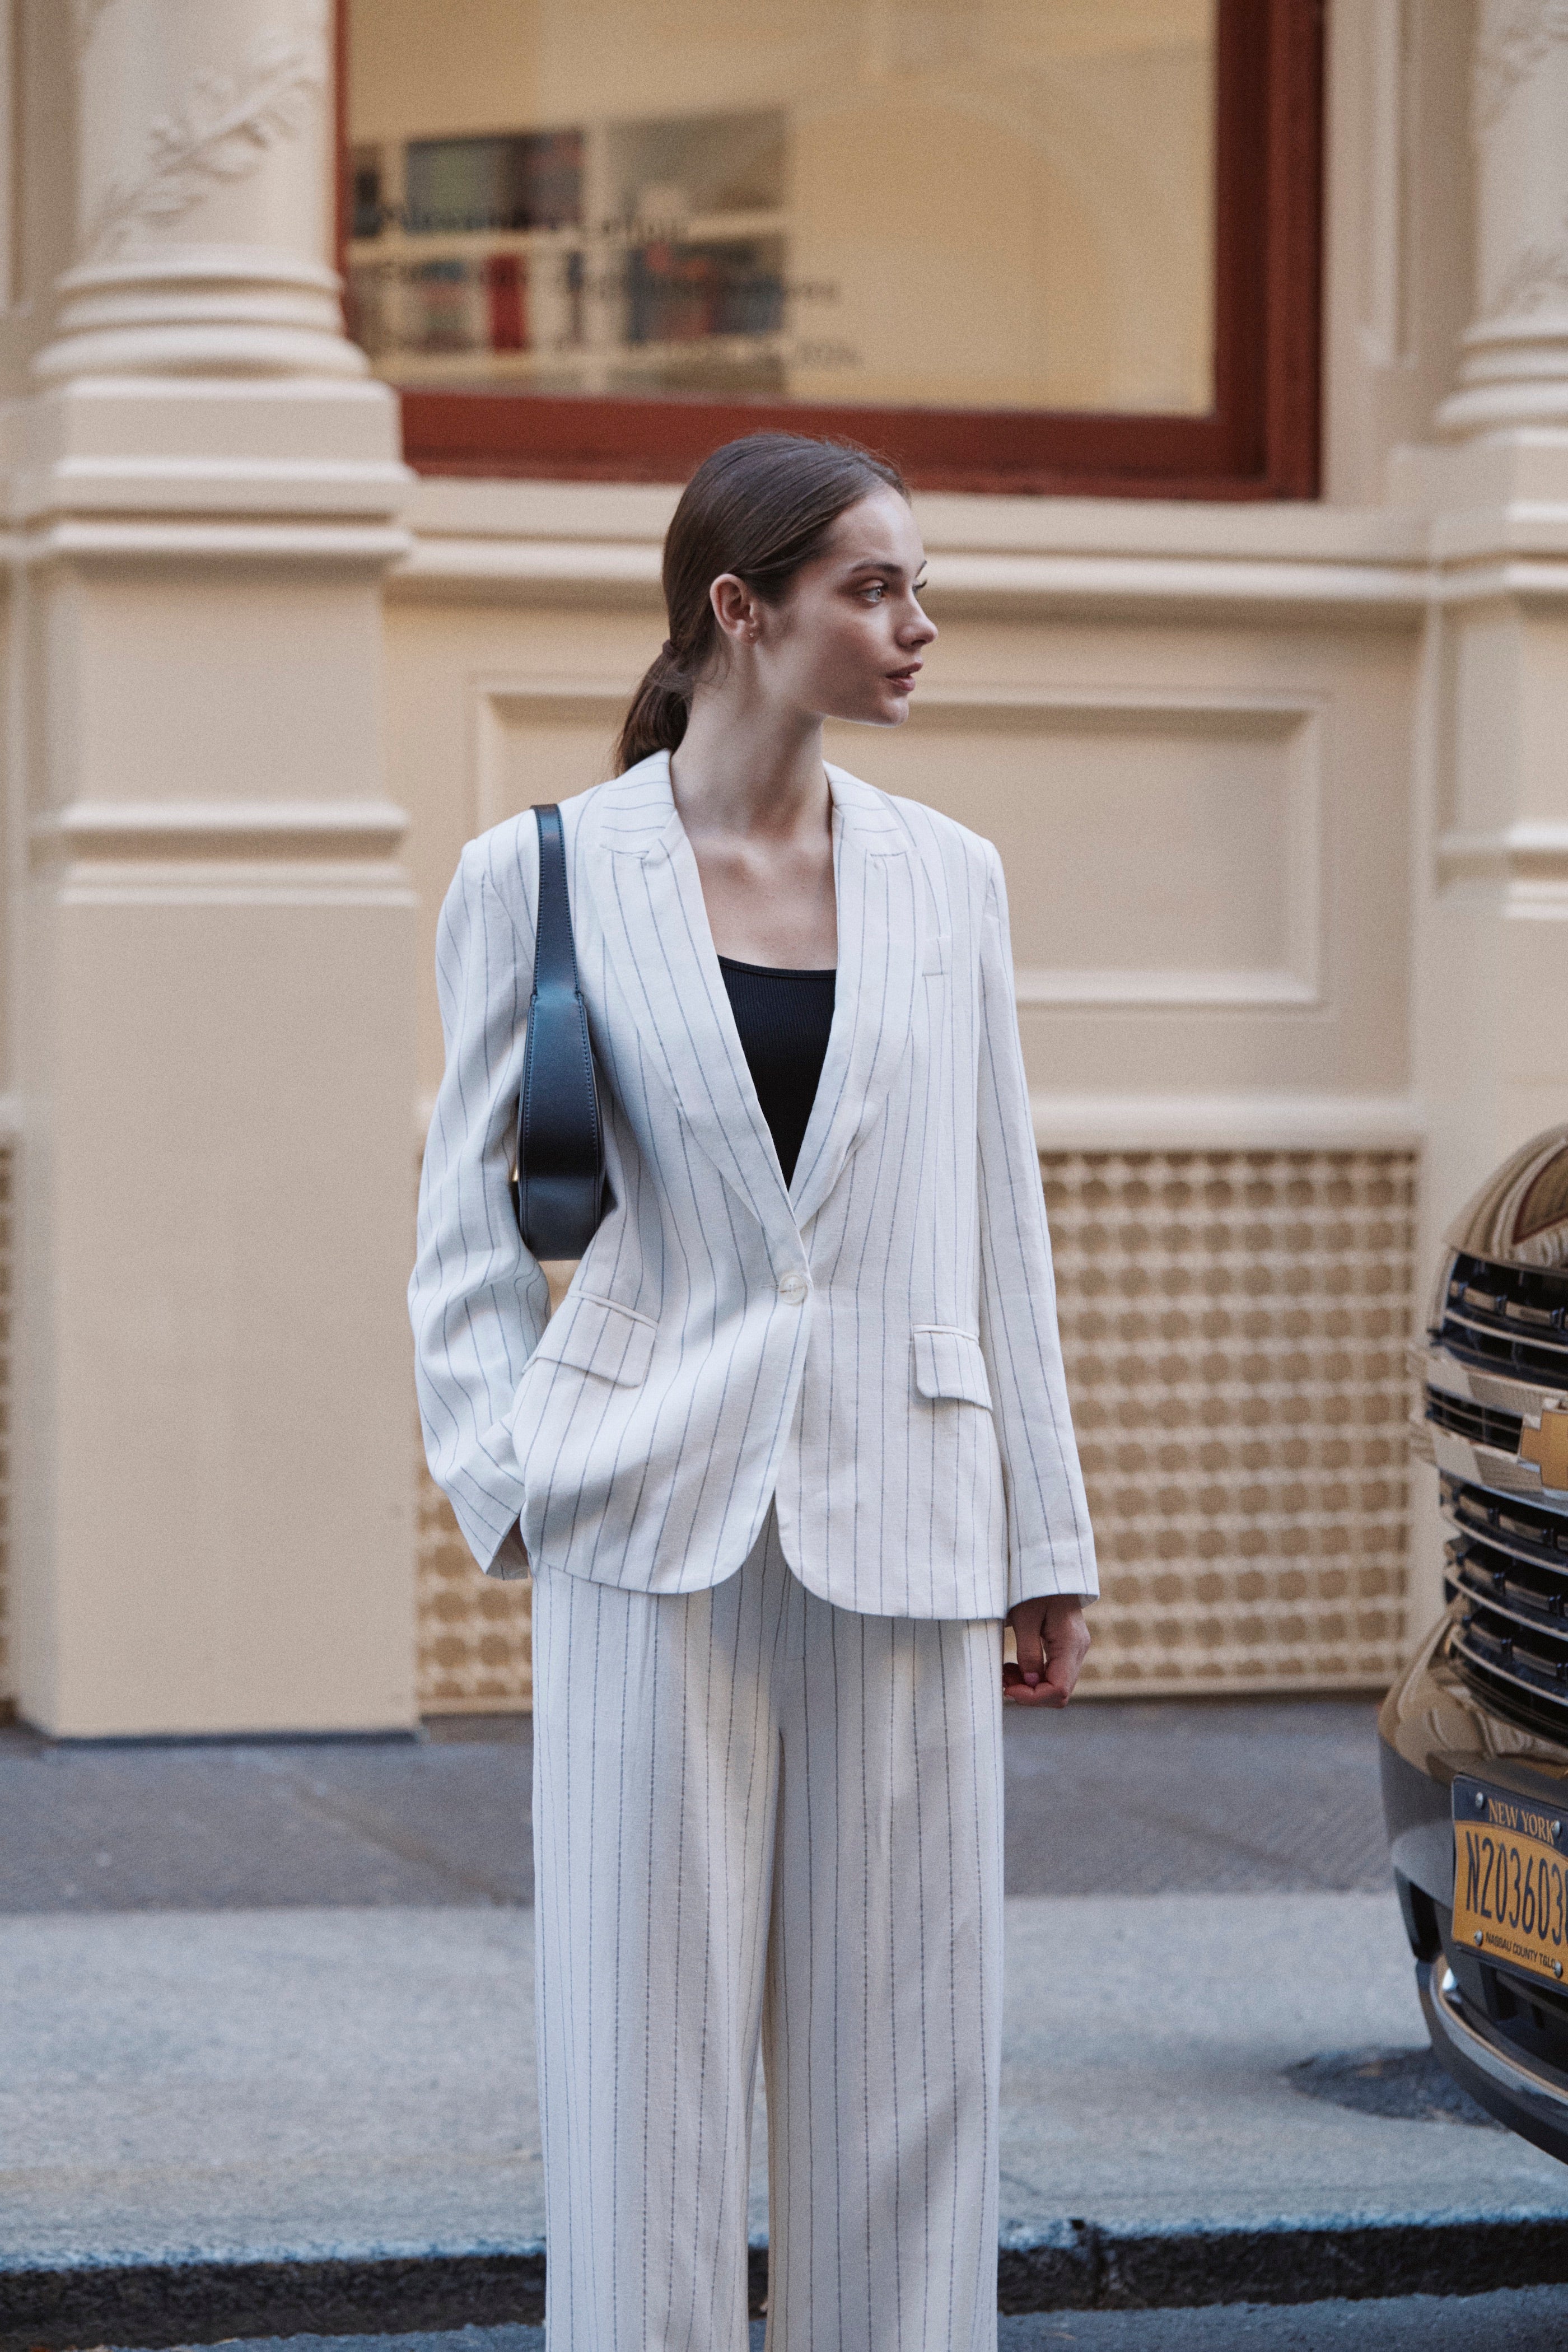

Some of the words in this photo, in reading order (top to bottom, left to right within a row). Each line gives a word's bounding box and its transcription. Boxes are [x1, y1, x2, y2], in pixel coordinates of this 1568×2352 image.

[1487, 1798, 1518, 1830] NEW
[1520, 1809, 1555, 1846] YORK
[1466, 1831, 1568, 1945] N203603
[1486, 1931, 1512, 1952] NASSAU
[1513, 1942, 1538, 1962] COUNTY
